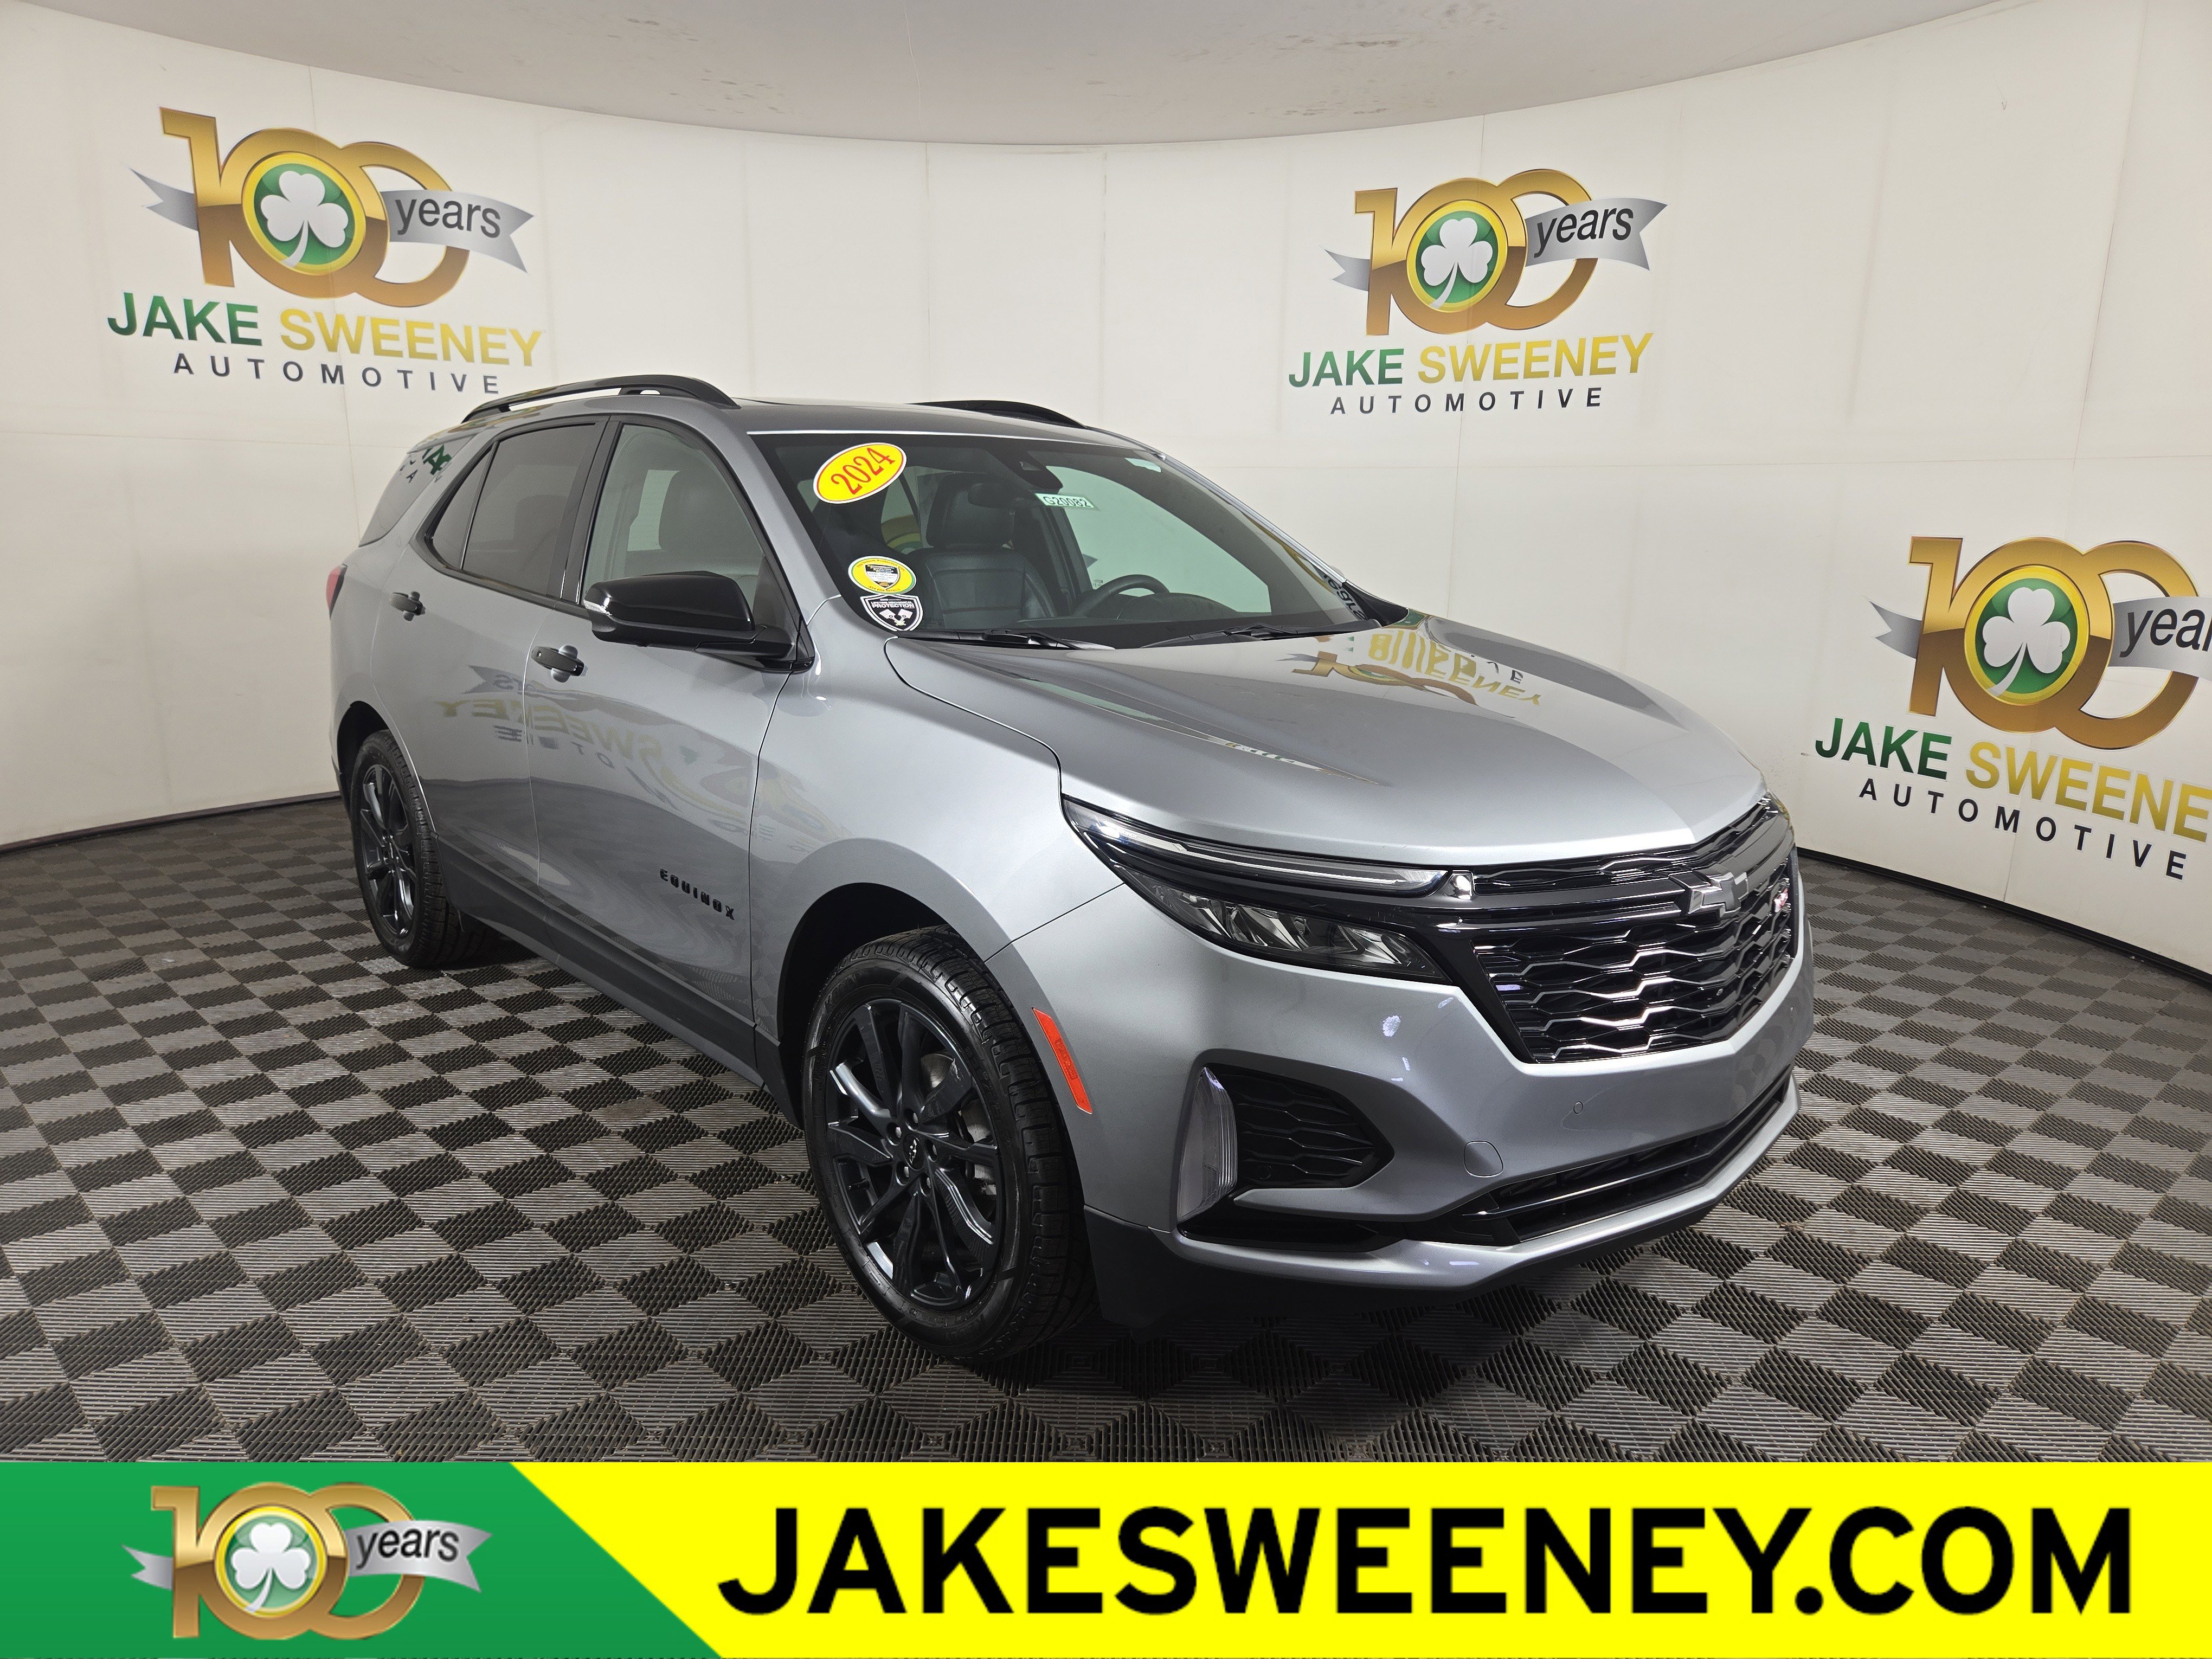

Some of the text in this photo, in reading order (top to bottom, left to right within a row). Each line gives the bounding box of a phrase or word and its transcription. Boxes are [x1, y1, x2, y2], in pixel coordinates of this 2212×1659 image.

[159, 107, 501, 307] 100 years
[1354, 168, 1634, 336] 100 years
[107, 292, 543, 367] JAKE SWEENEY
[173, 352, 500, 395] AUTOMOTIVE
[1288, 332, 1654, 387] JAKE SWEENEY
[1330, 387, 1603, 415] AUTOMOTIVE
[830, 446, 896, 495] 2024
[1043, 496, 1091, 507] G20082
[1908, 536, 2199, 750] 100
[1815, 717, 1952, 781] JAKE
[1859, 777, 2187, 881] AUTOMOTIVE
[660, 869, 735, 920] EQUINOX
